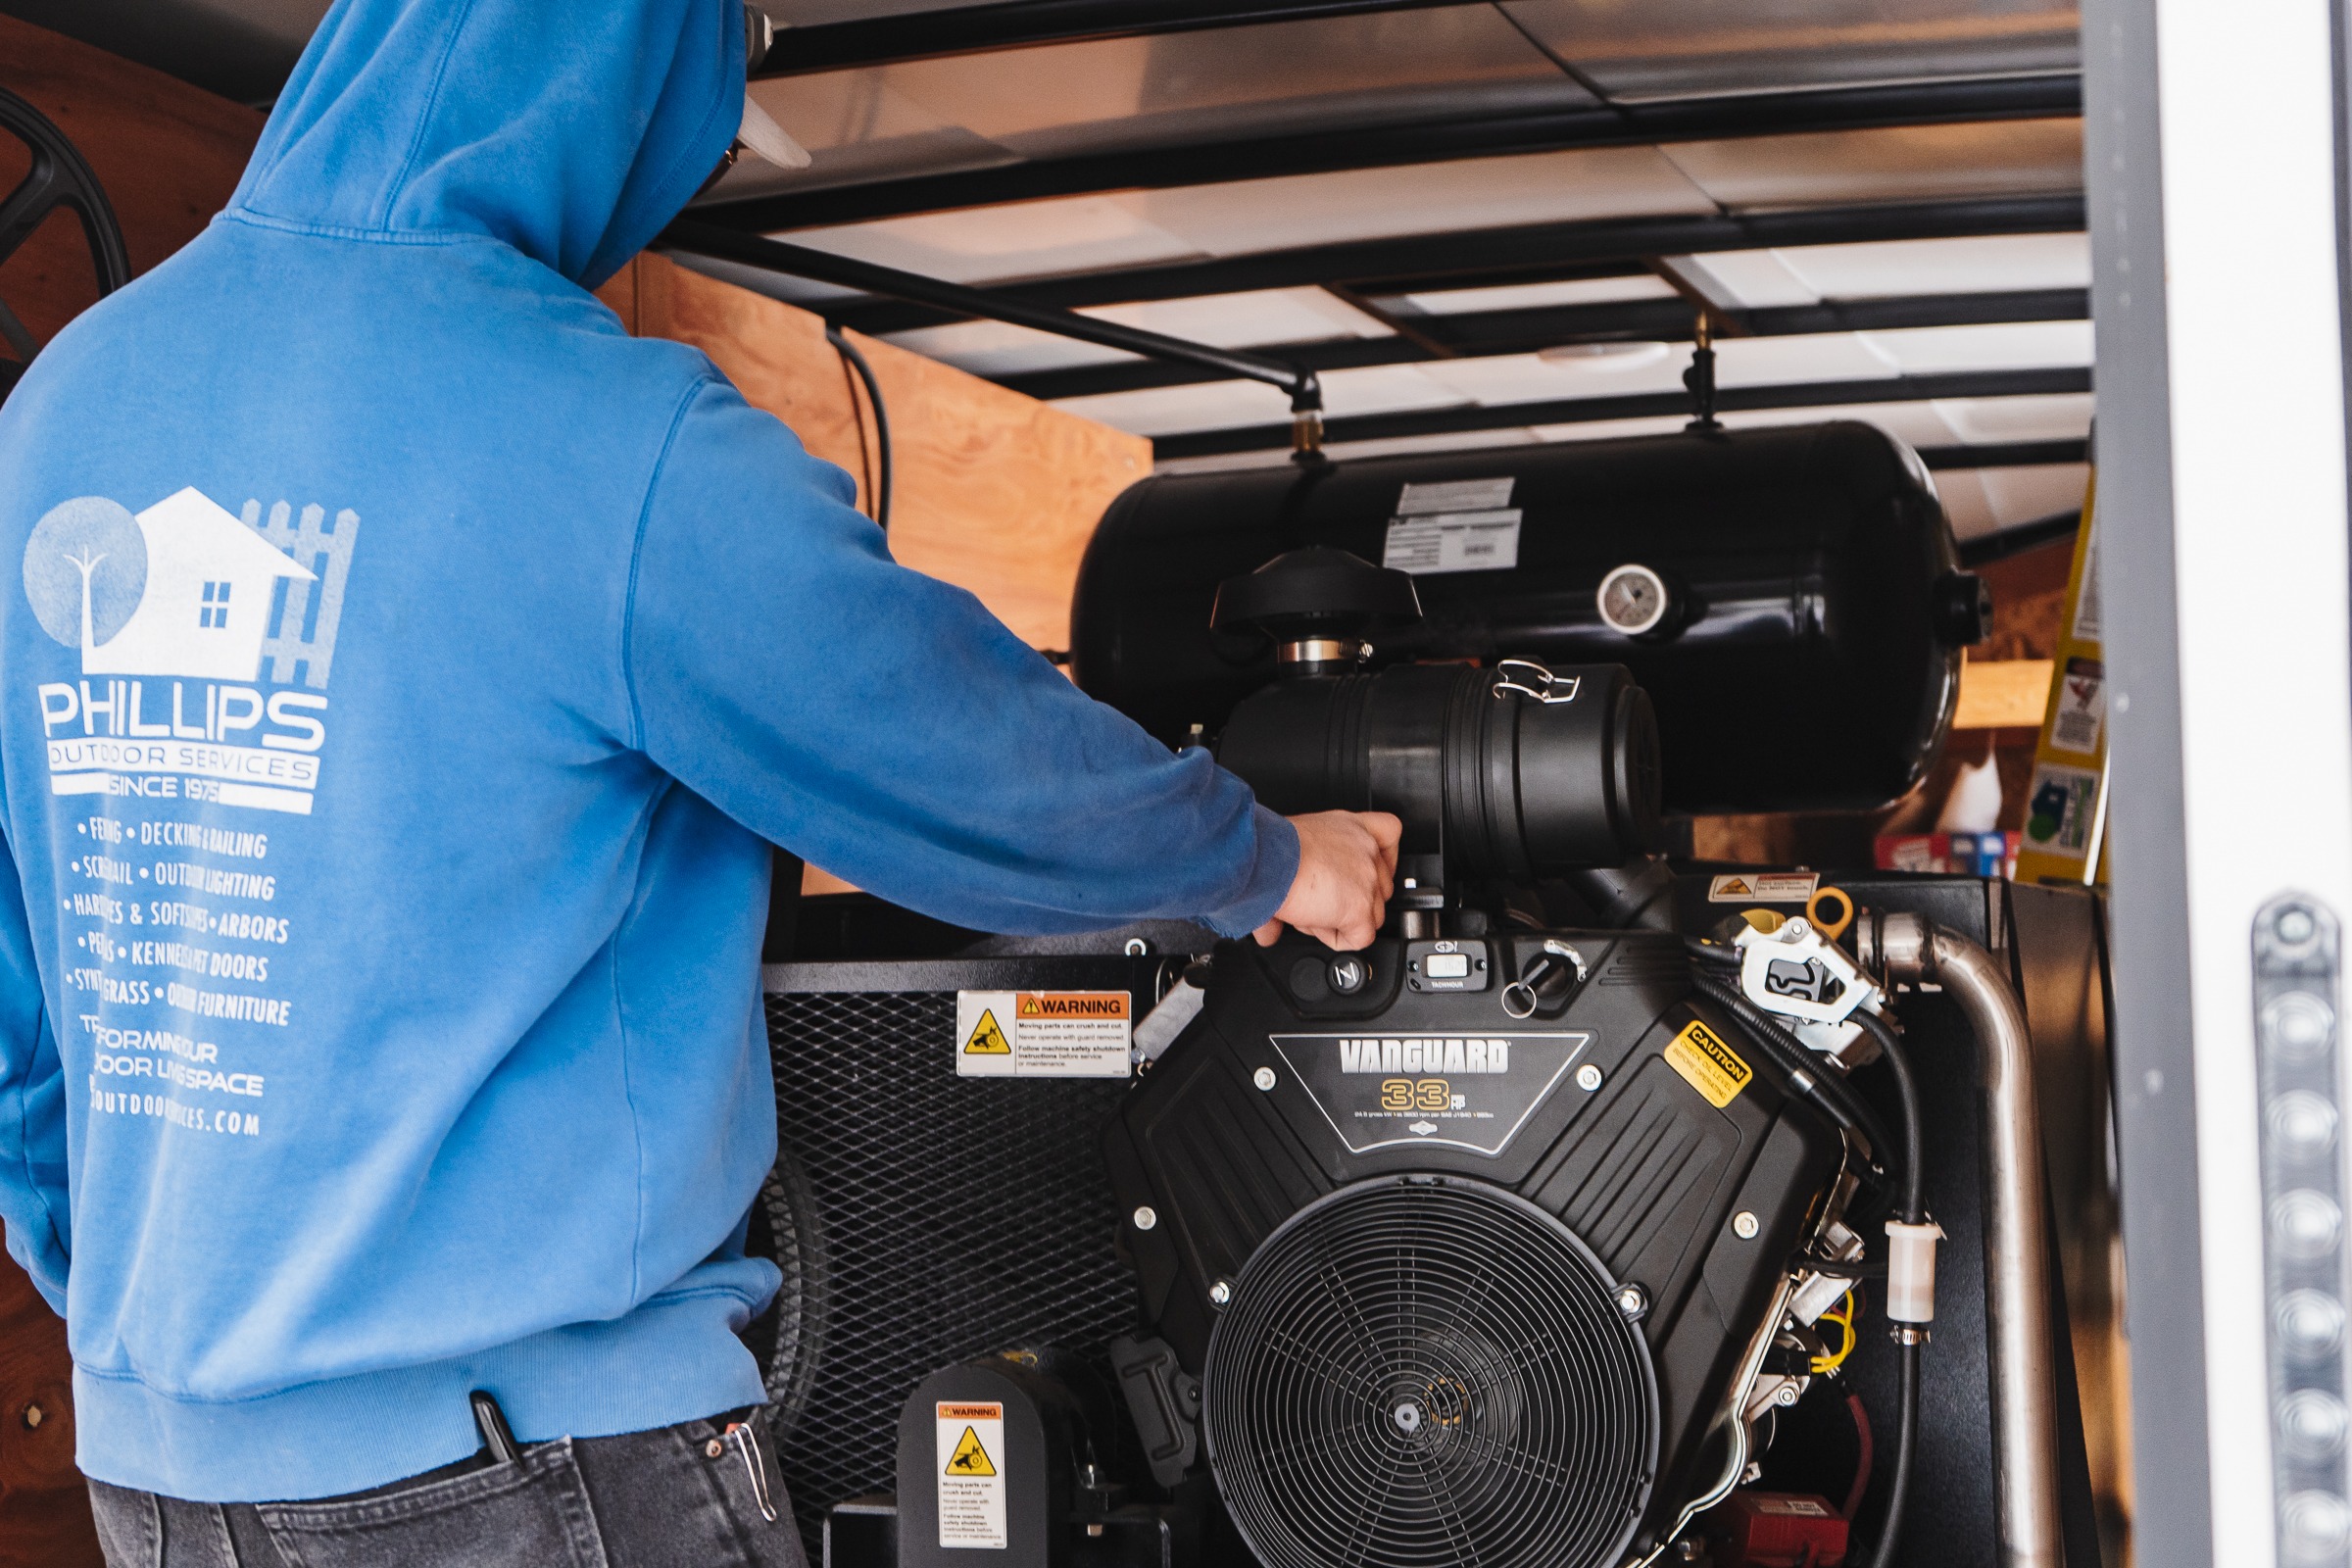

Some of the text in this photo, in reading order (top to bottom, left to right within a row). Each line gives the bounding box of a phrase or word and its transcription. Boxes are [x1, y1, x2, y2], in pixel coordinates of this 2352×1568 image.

[37, 680, 328, 753] PHILLIPS
[50, 743, 313, 780] OUTDOOR SERVICES
[109, 774, 220, 803] SINCE 1975
[205, 867, 276, 901] LIGHTING
[129, 903, 143, 925] &
[218, 911, 290, 945] ARBORS
[209, 952, 270, 982] DOORS
[104, 978, 151, 1004] GRASS
[197, 990, 292, 1027] FURNITURE
[1042, 1000, 1120, 1014] WARNING
[1339, 1039, 1509, 1074] VANGUARD
[1680, 1040, 1701, 1061] CHECK
[1713, 1070, 1733, 1092] LEVEL
[1691, 1028, 1744, 1081] CAUTION
[185, 1067, 265, 1097] SPACE
[1381, 1078, 1449, 1111] 33
[1694, 1068, 1728, 1100] OPERATING
[952, 1407, 997, 1417] WARNING
